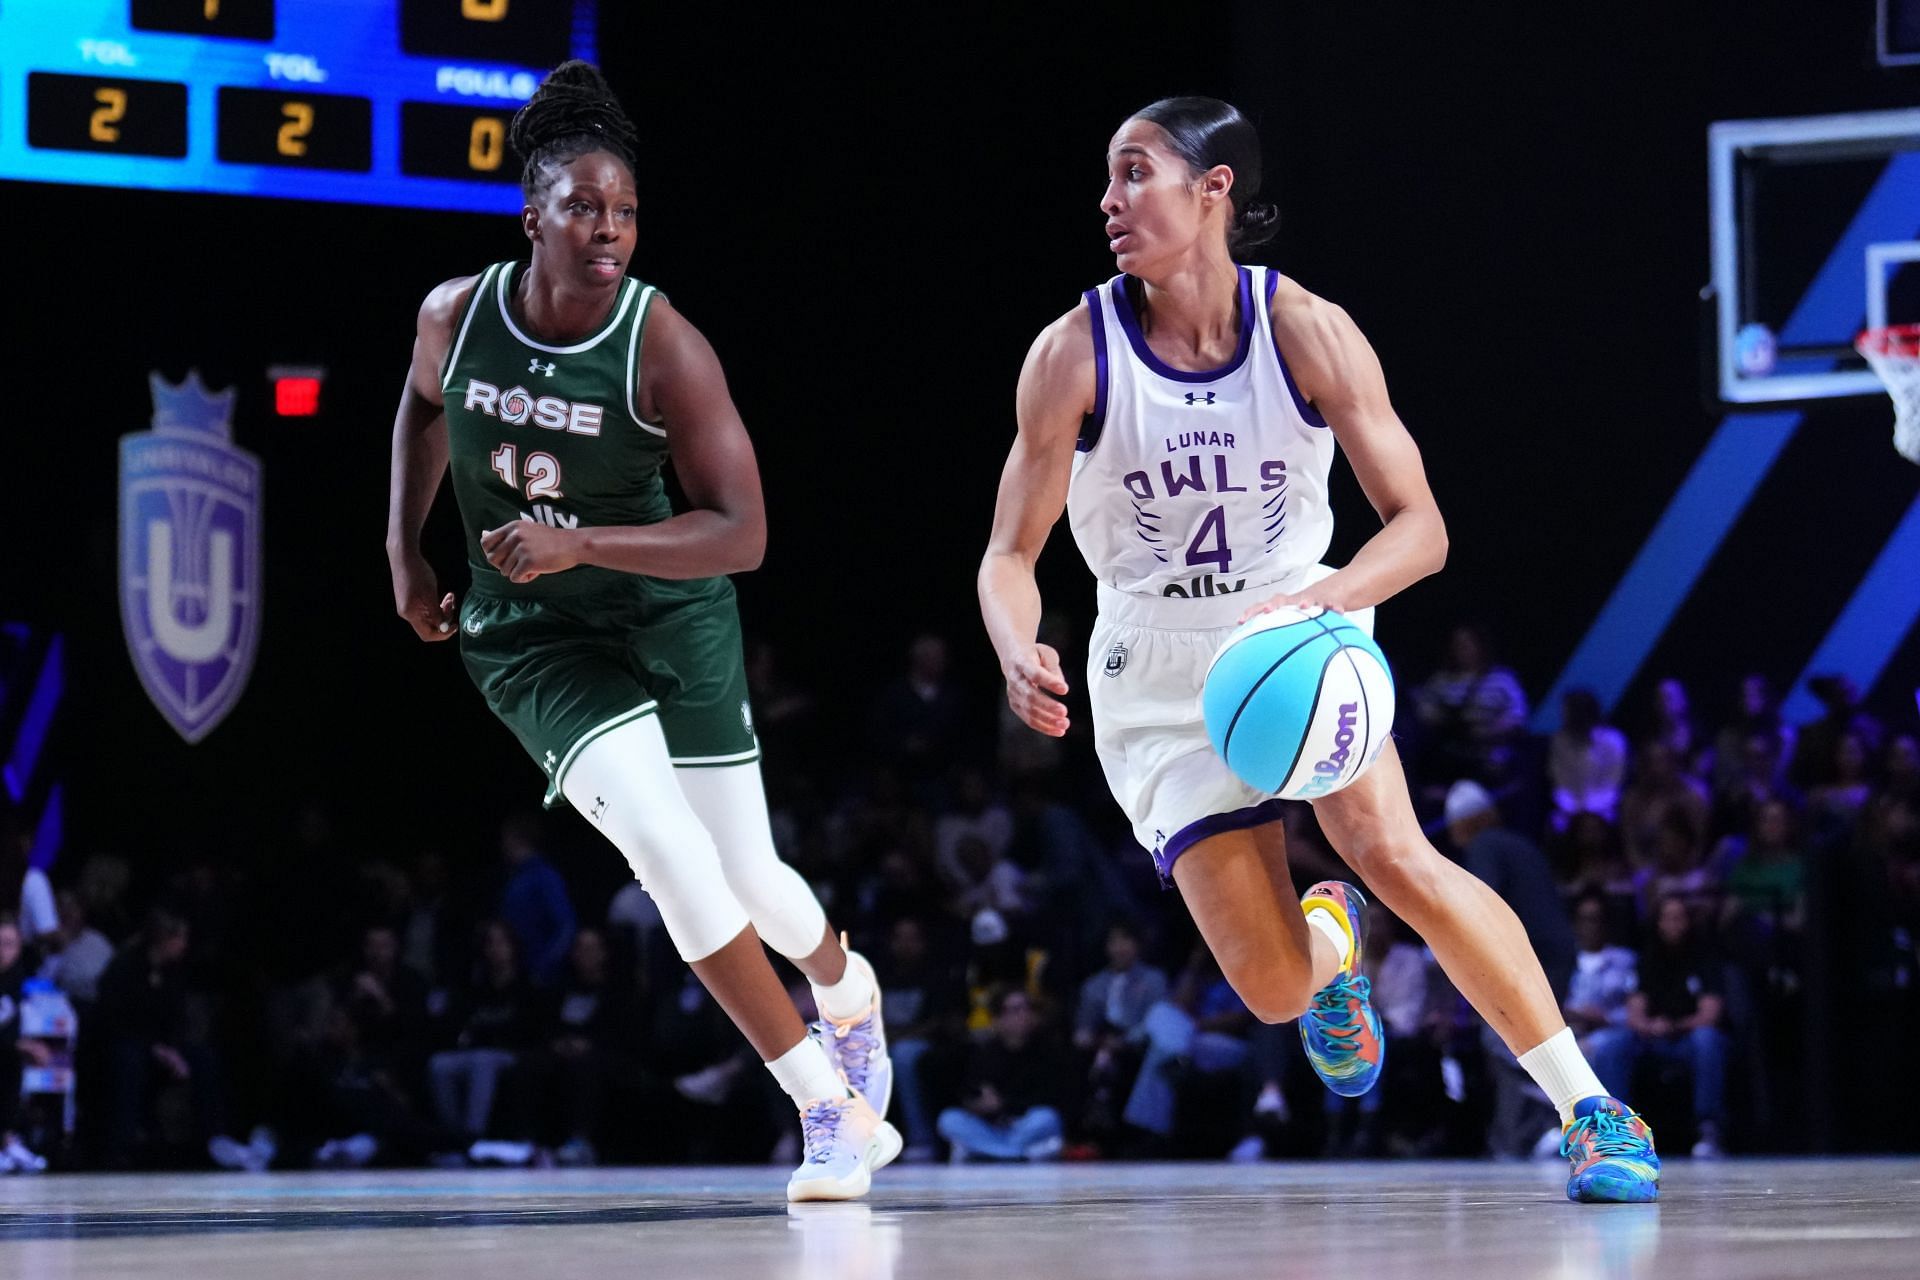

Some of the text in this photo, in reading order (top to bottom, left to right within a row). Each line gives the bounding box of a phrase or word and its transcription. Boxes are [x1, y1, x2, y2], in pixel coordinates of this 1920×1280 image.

[89, 87, 127, 143] 2
[276, 101, 315, 157] 2
[469, 116, 504, 171] 0
[464, 378, 604, 437] ROSE
[1166, 431, 1236, 452] LUNAR
[491, 443, 564, 501] 12
[1123, 454, 1288, 500] OWLS
[520, 504, 578, 529] lly
[1185, 504, 1232, 574] 4
